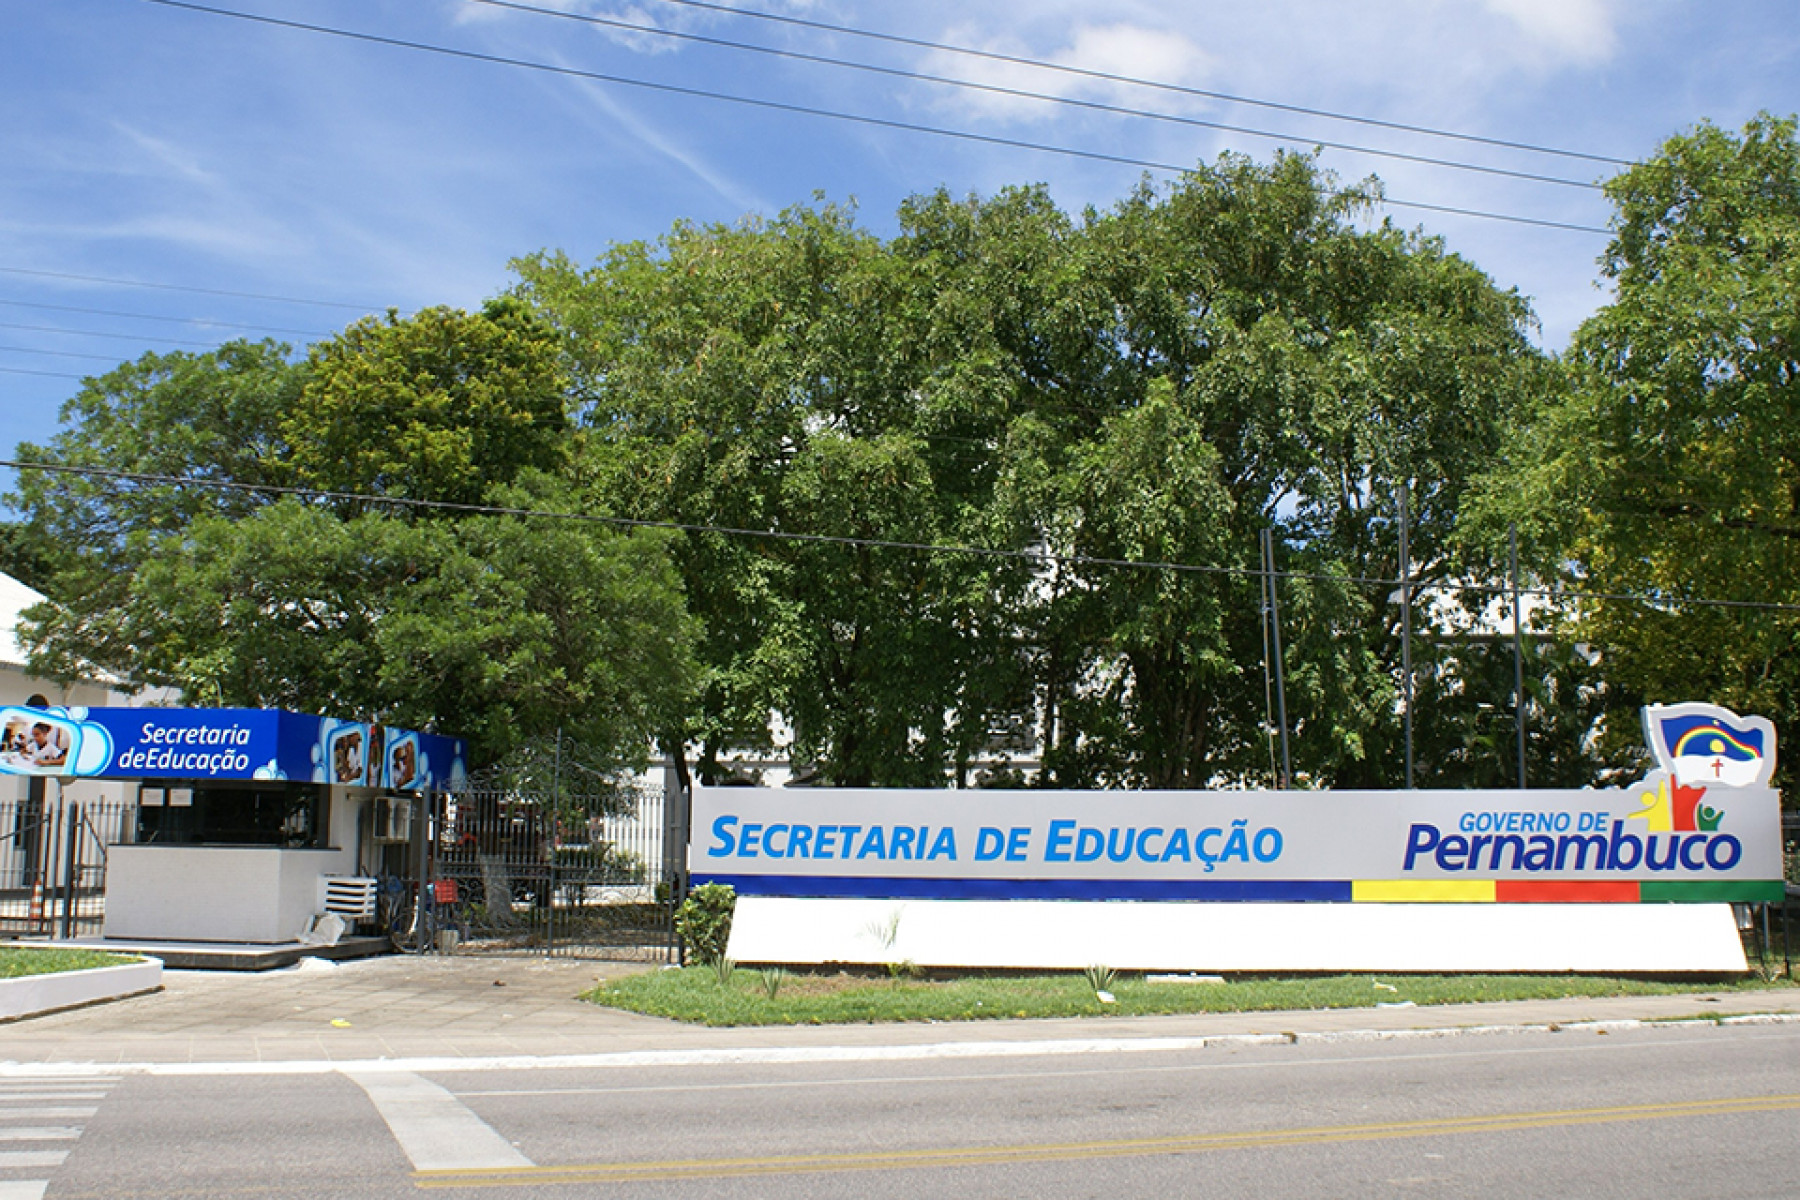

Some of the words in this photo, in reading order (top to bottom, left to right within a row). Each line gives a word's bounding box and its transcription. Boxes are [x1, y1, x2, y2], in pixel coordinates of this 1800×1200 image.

[139, 722, 250, 745] Secretaria
[1459, 811, 1571, 833] GOVERNO
[1576, 811, 1610, 833] DE
[708, 815, 957, 861] SECRETARIA
[974, 826, 1032, 862] DE
[1044, 819, 1284, 873] EDUCAÇÃO
[1403, 819, 1743, 872] Pernambuco
